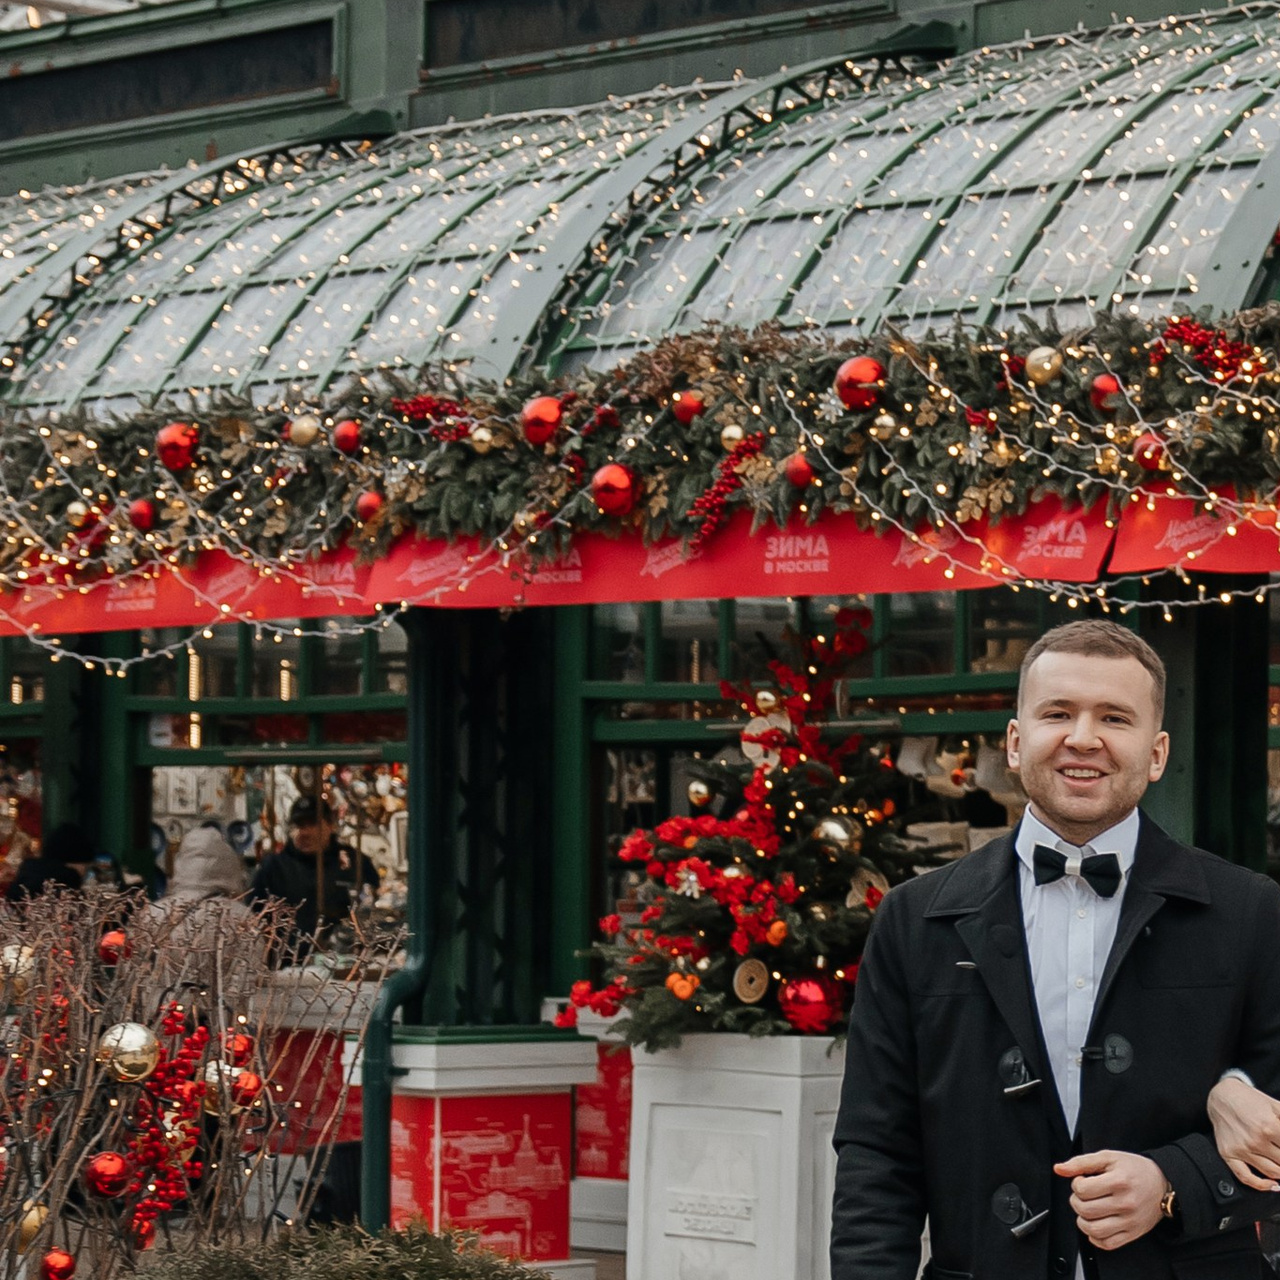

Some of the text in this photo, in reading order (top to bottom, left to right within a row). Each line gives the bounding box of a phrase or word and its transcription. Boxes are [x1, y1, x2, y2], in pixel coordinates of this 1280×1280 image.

[765, 535, 829, 558] ЗИМА
[763, 559, 829, 574] В МОСКВЕ
